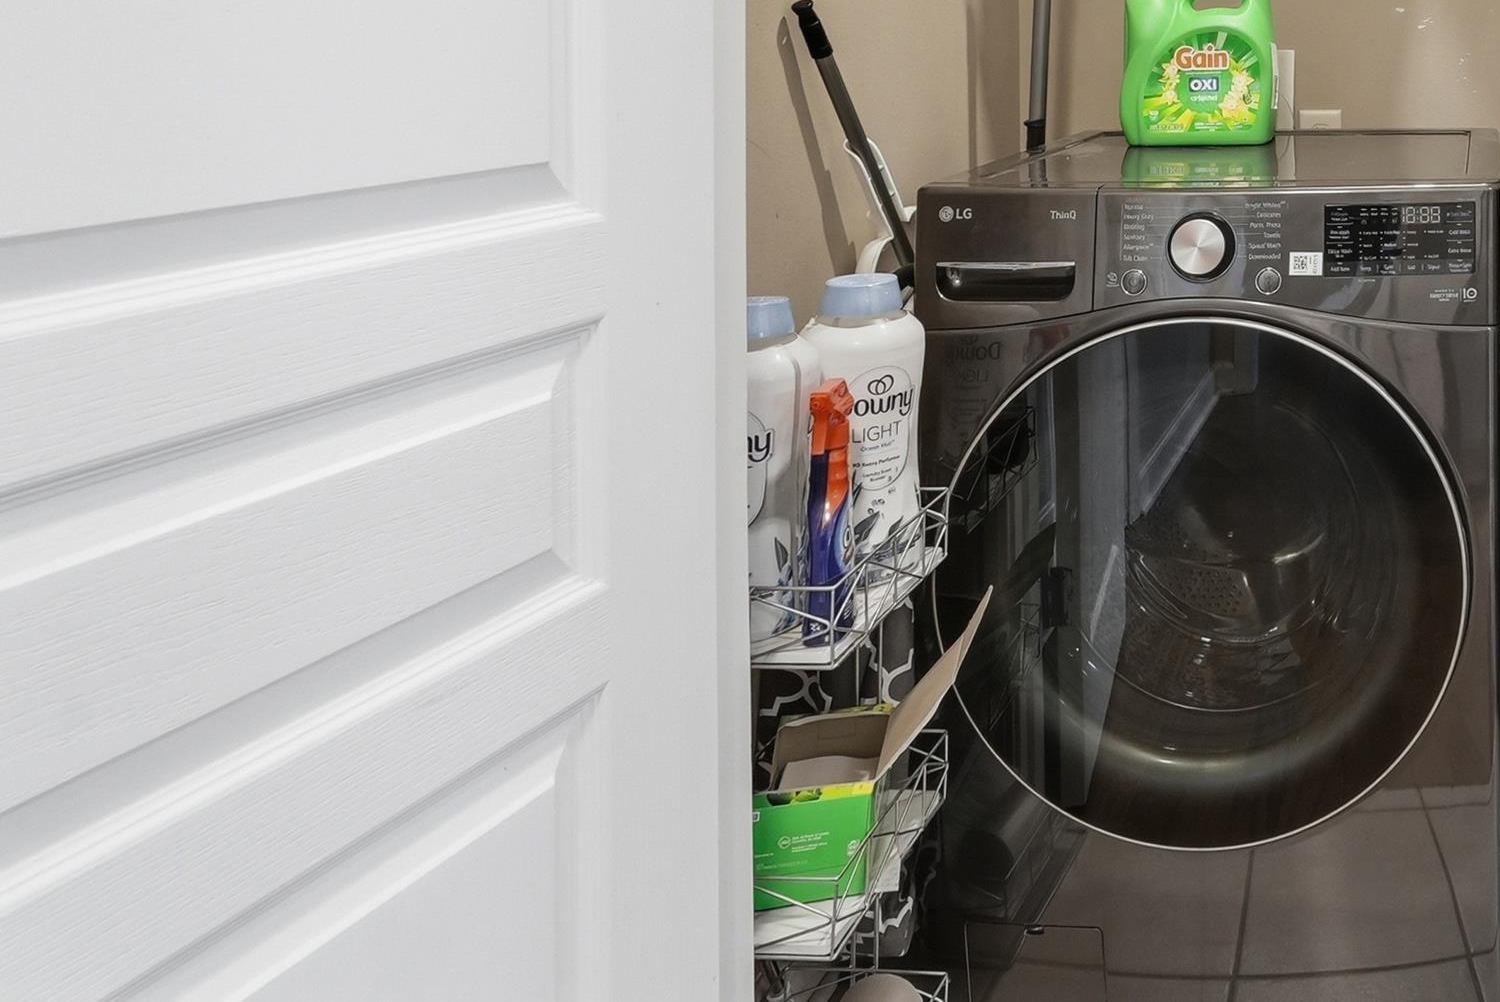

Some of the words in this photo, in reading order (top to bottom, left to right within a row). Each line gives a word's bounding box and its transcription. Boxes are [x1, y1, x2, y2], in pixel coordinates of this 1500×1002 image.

[1175, 43, 1229, 70] Gain
[1190, 79, 1218, 91] OXI
[956, 208, 972, 219] LG
[1050, 210, 1077, 220] ThinQ
[853, 388, 913, 417] owny
[852, 420, 902, 444] LIGHT
